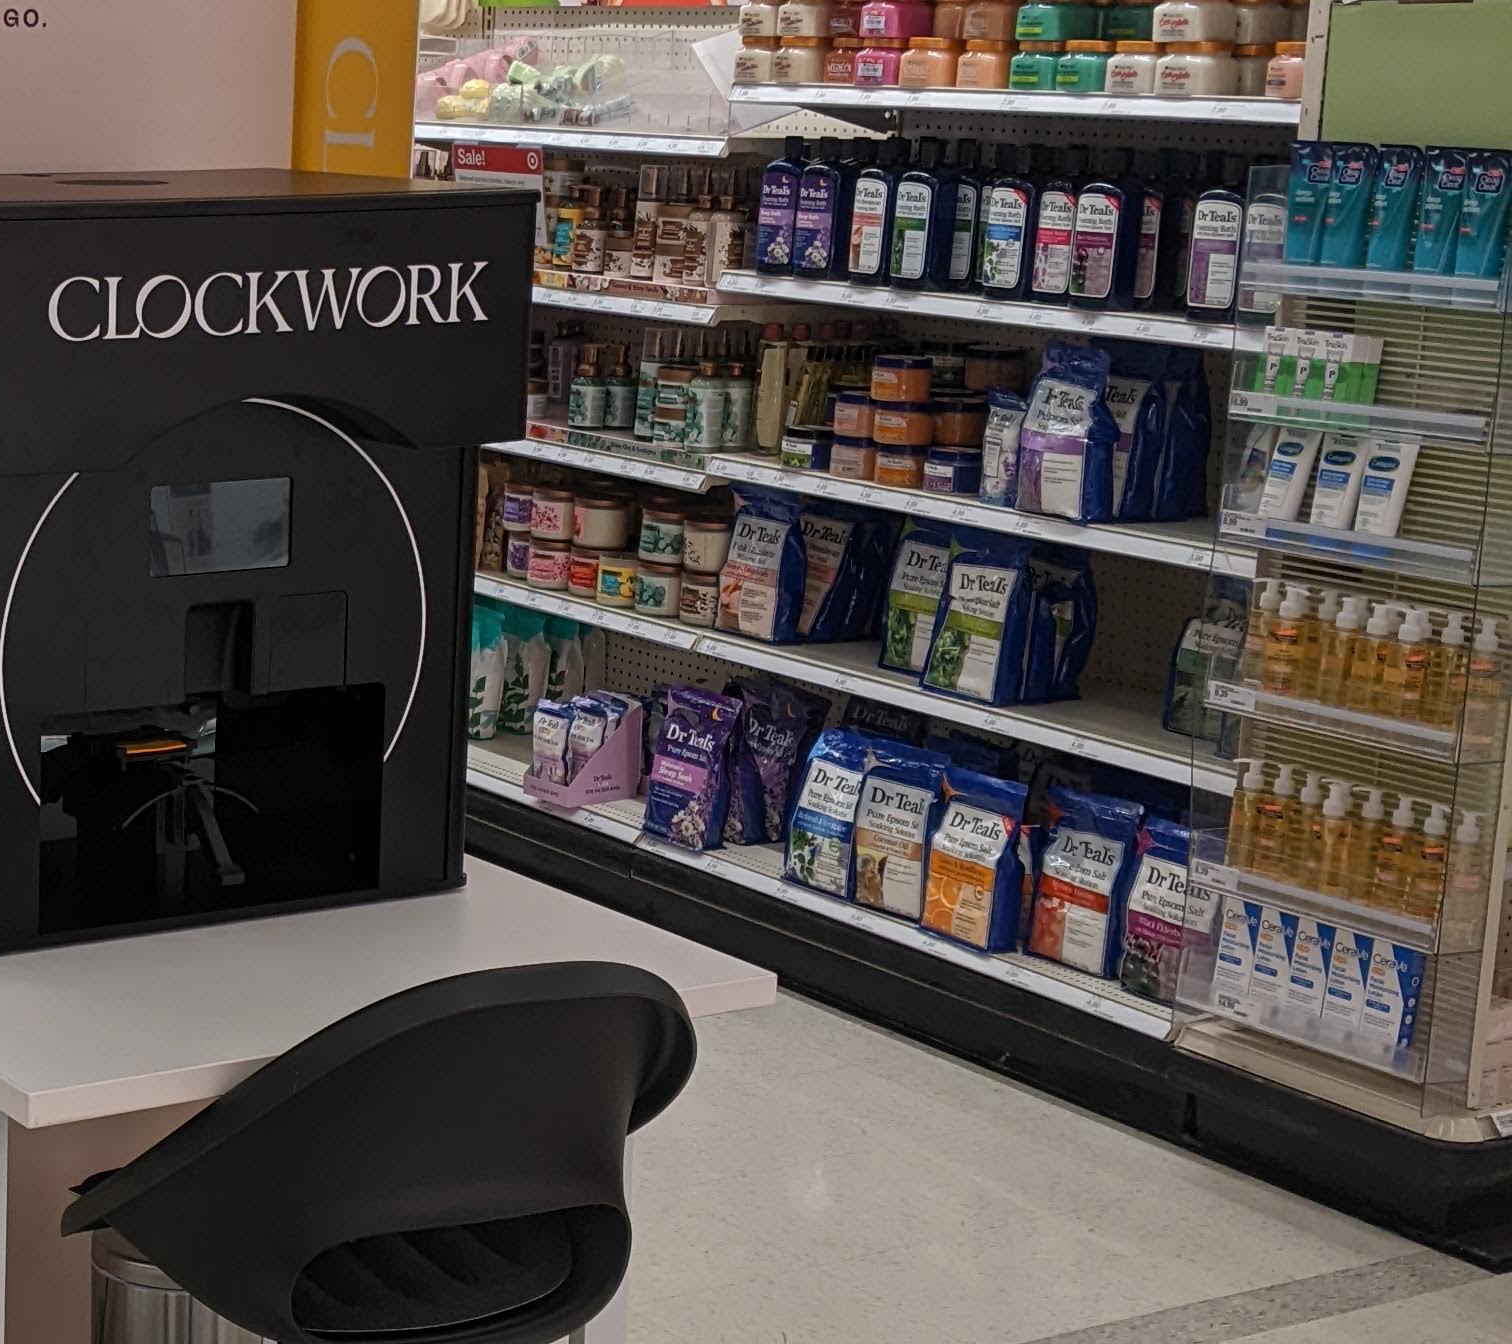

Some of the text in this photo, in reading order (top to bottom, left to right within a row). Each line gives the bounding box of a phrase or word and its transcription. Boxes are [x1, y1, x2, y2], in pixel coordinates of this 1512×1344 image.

[3, 8, 47, 29] GO.
[457, 148, 486, 166] Sale!
[1197, 210, 1208, 221] Dr
[47, 261, 489, 343] CLOCKWORK
[1270, 363, 1277, 371] P
[1300, 367, 1307, 375] P
[1329, 370, 1336, 379] P
[737, 522, 781, 545] Dr Teal's
[906, 550, 927, 569] Dr
[959, 573, 1009, 595] Dr Teal's
[666, 723, 716, 752] Dr Teal's
[812, 767, 833, 787] Dr
[870, 785, 895, 804] Dr
[866, 808, 910, 828] Pure Epsom
[949, 811, 1003, 841] Dr Teal's
[1062, 835, 1116, 867] Dr Teal's
[1146, 866, 1211, 902] Dr Teal's
[1158, 896, 1186, 912] Epsom
[1226, 909, 1258, 927] CeraVe
[1261, 919, 1294, 938] CeraVe
[1298, 931, 1331, 950] CeraVe
[1335, 942, 1369, 961] CeraVe
[1373, 954, 1408, 973] CeraVe
